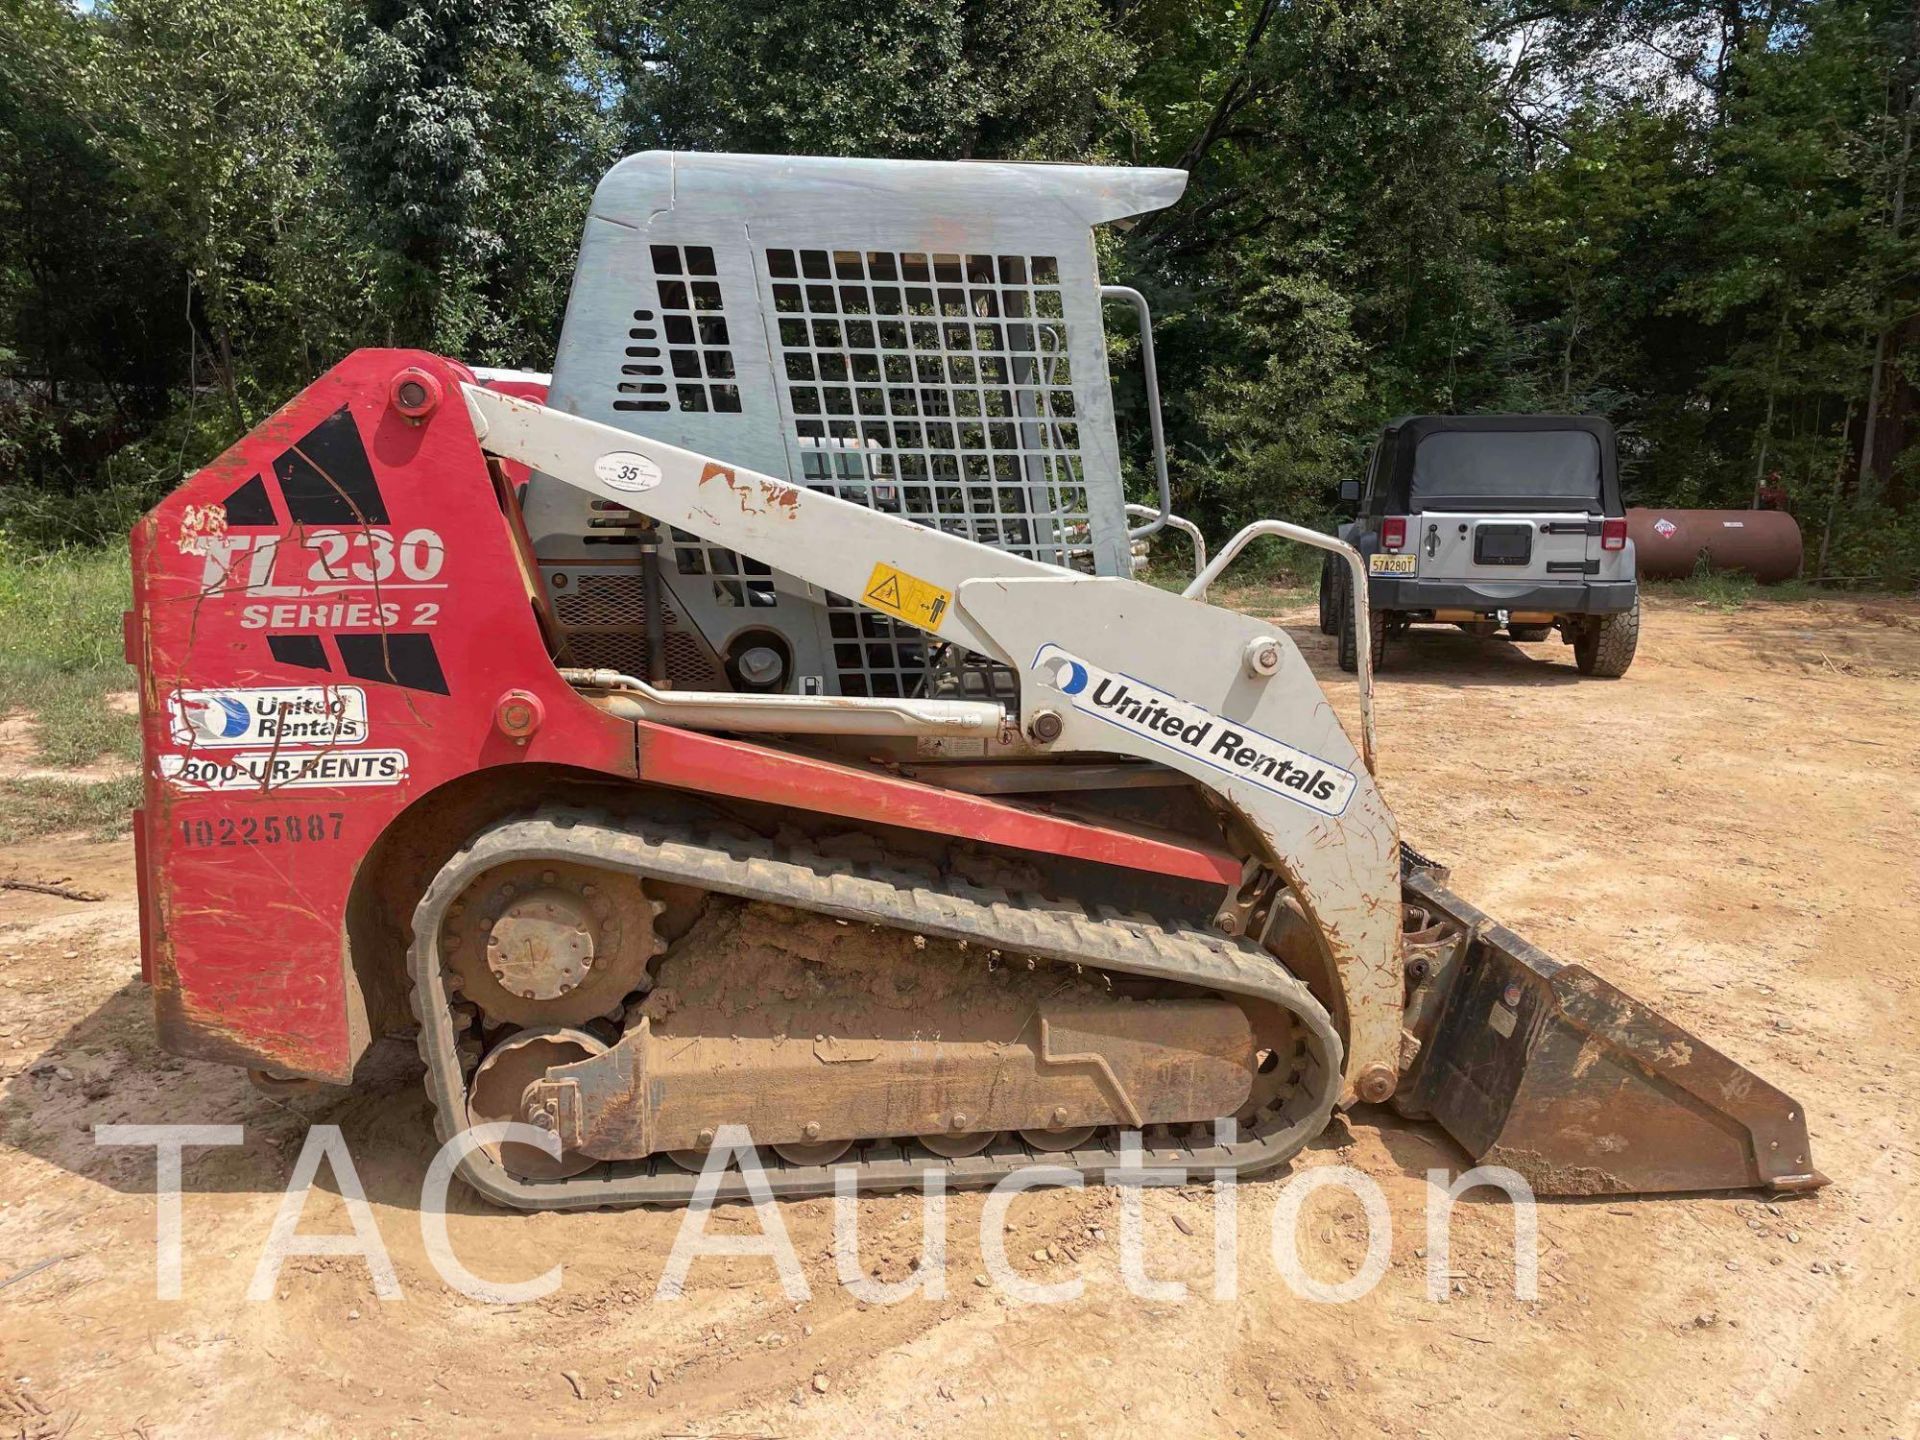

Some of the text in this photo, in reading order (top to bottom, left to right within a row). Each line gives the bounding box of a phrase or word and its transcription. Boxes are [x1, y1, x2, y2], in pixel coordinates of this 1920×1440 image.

[618, 465, 639, 480] 35
[198, 529, 445, 598] TL 230
[240, 603, 440, 629] SERIES 2
[257, 697, 344, 717] United
[1091, 678, 1336, 800] United Rentals
[180, 812, 344, 848] 10225887
